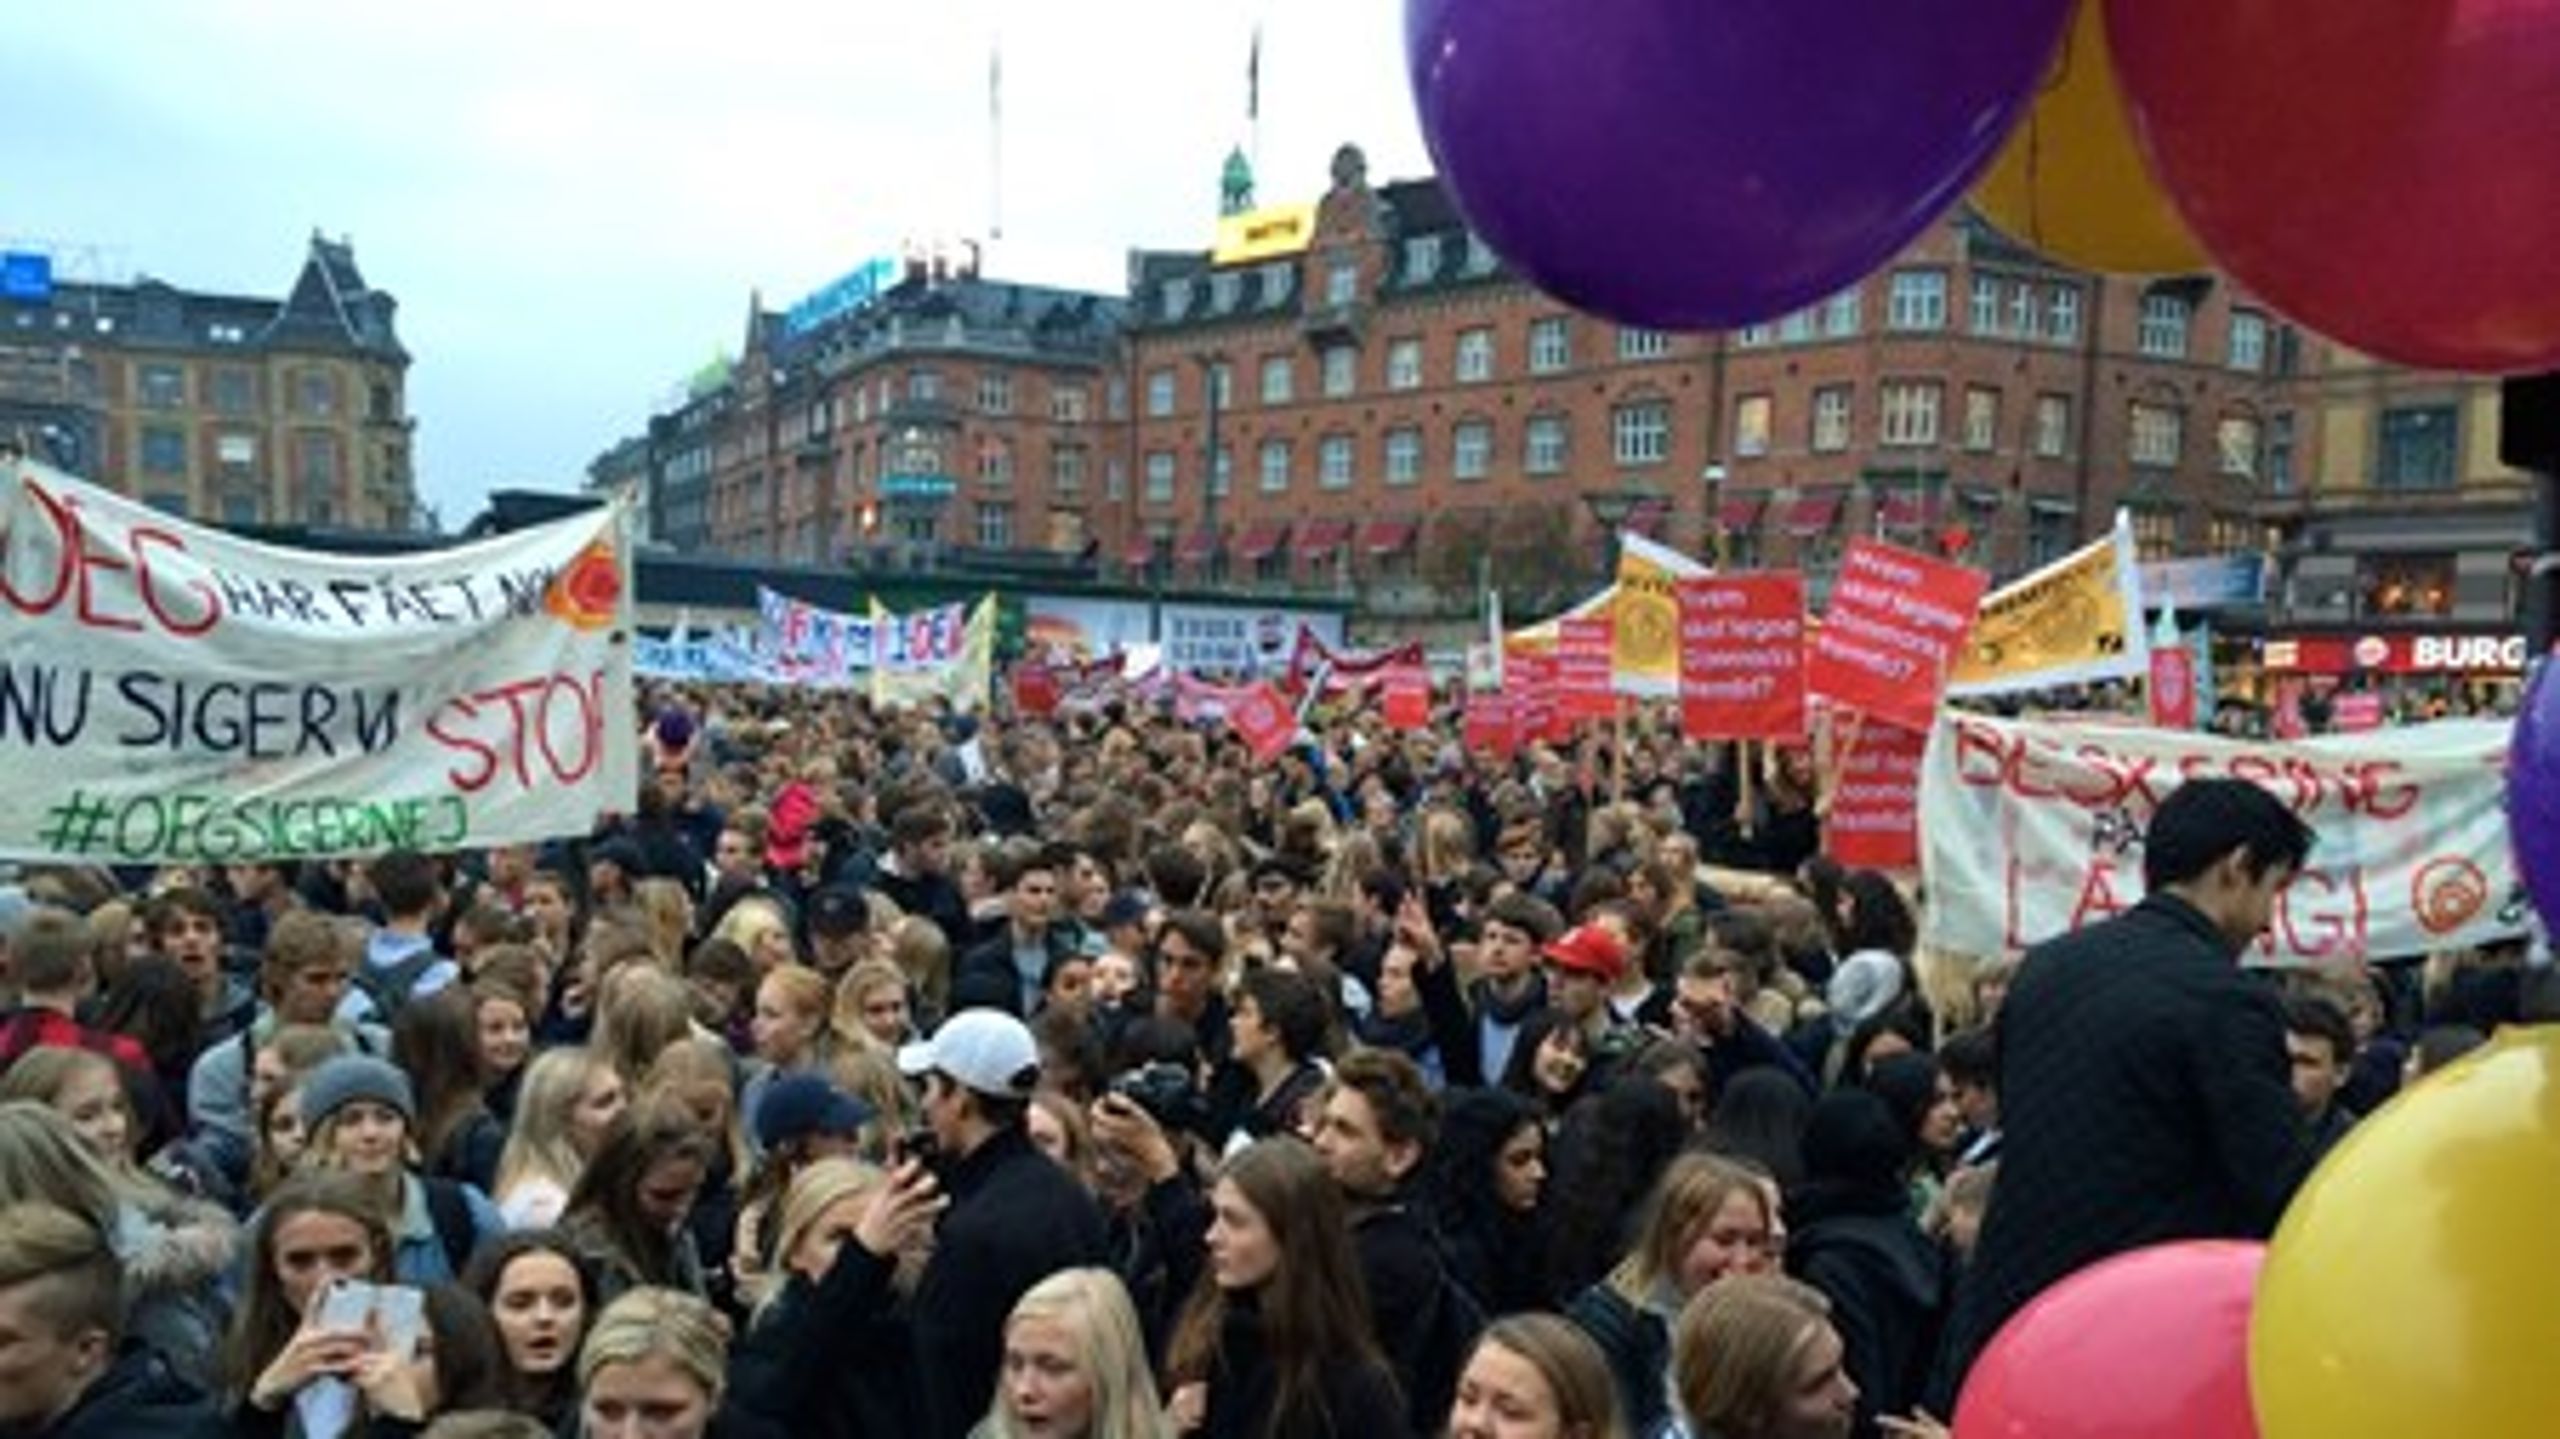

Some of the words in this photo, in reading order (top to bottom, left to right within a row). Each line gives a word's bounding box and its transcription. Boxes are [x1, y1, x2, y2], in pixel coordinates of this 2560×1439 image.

[211, 566, 331, 622] HAR
[0, 661, 92, 748] NU
[117, 669, 338, 758] SIGER
